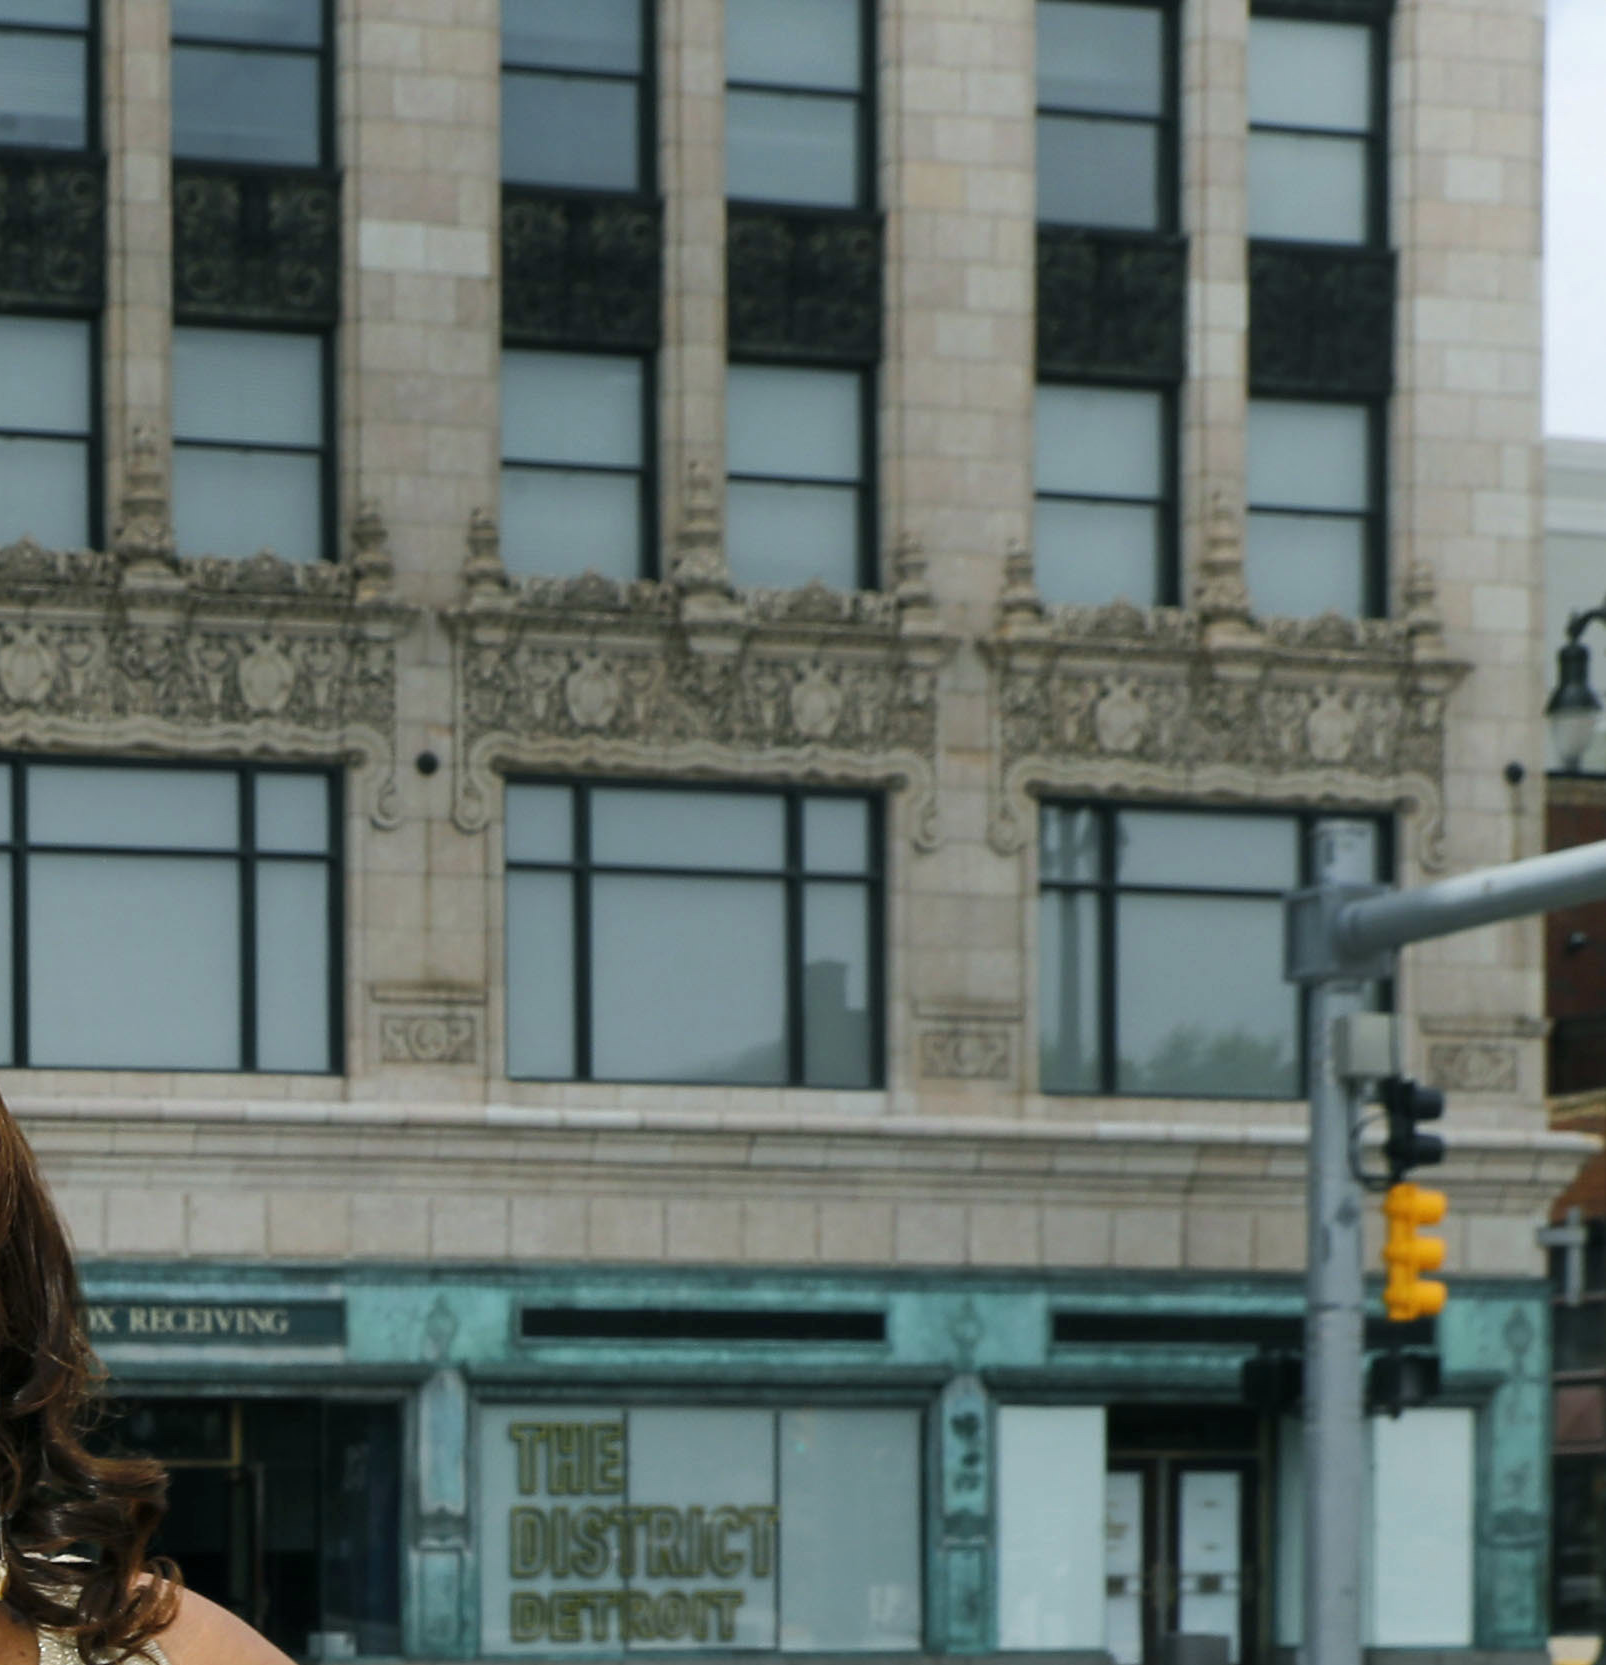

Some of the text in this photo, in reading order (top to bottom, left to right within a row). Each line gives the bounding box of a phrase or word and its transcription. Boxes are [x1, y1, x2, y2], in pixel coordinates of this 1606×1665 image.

[128, 1305, 290, 1336] RECEIVING
[508, 1421, 626, 1496] THE
[509, 1504, 780, 1580] DISTRICT
[509, 1589, 745, 1644] DETROIT
